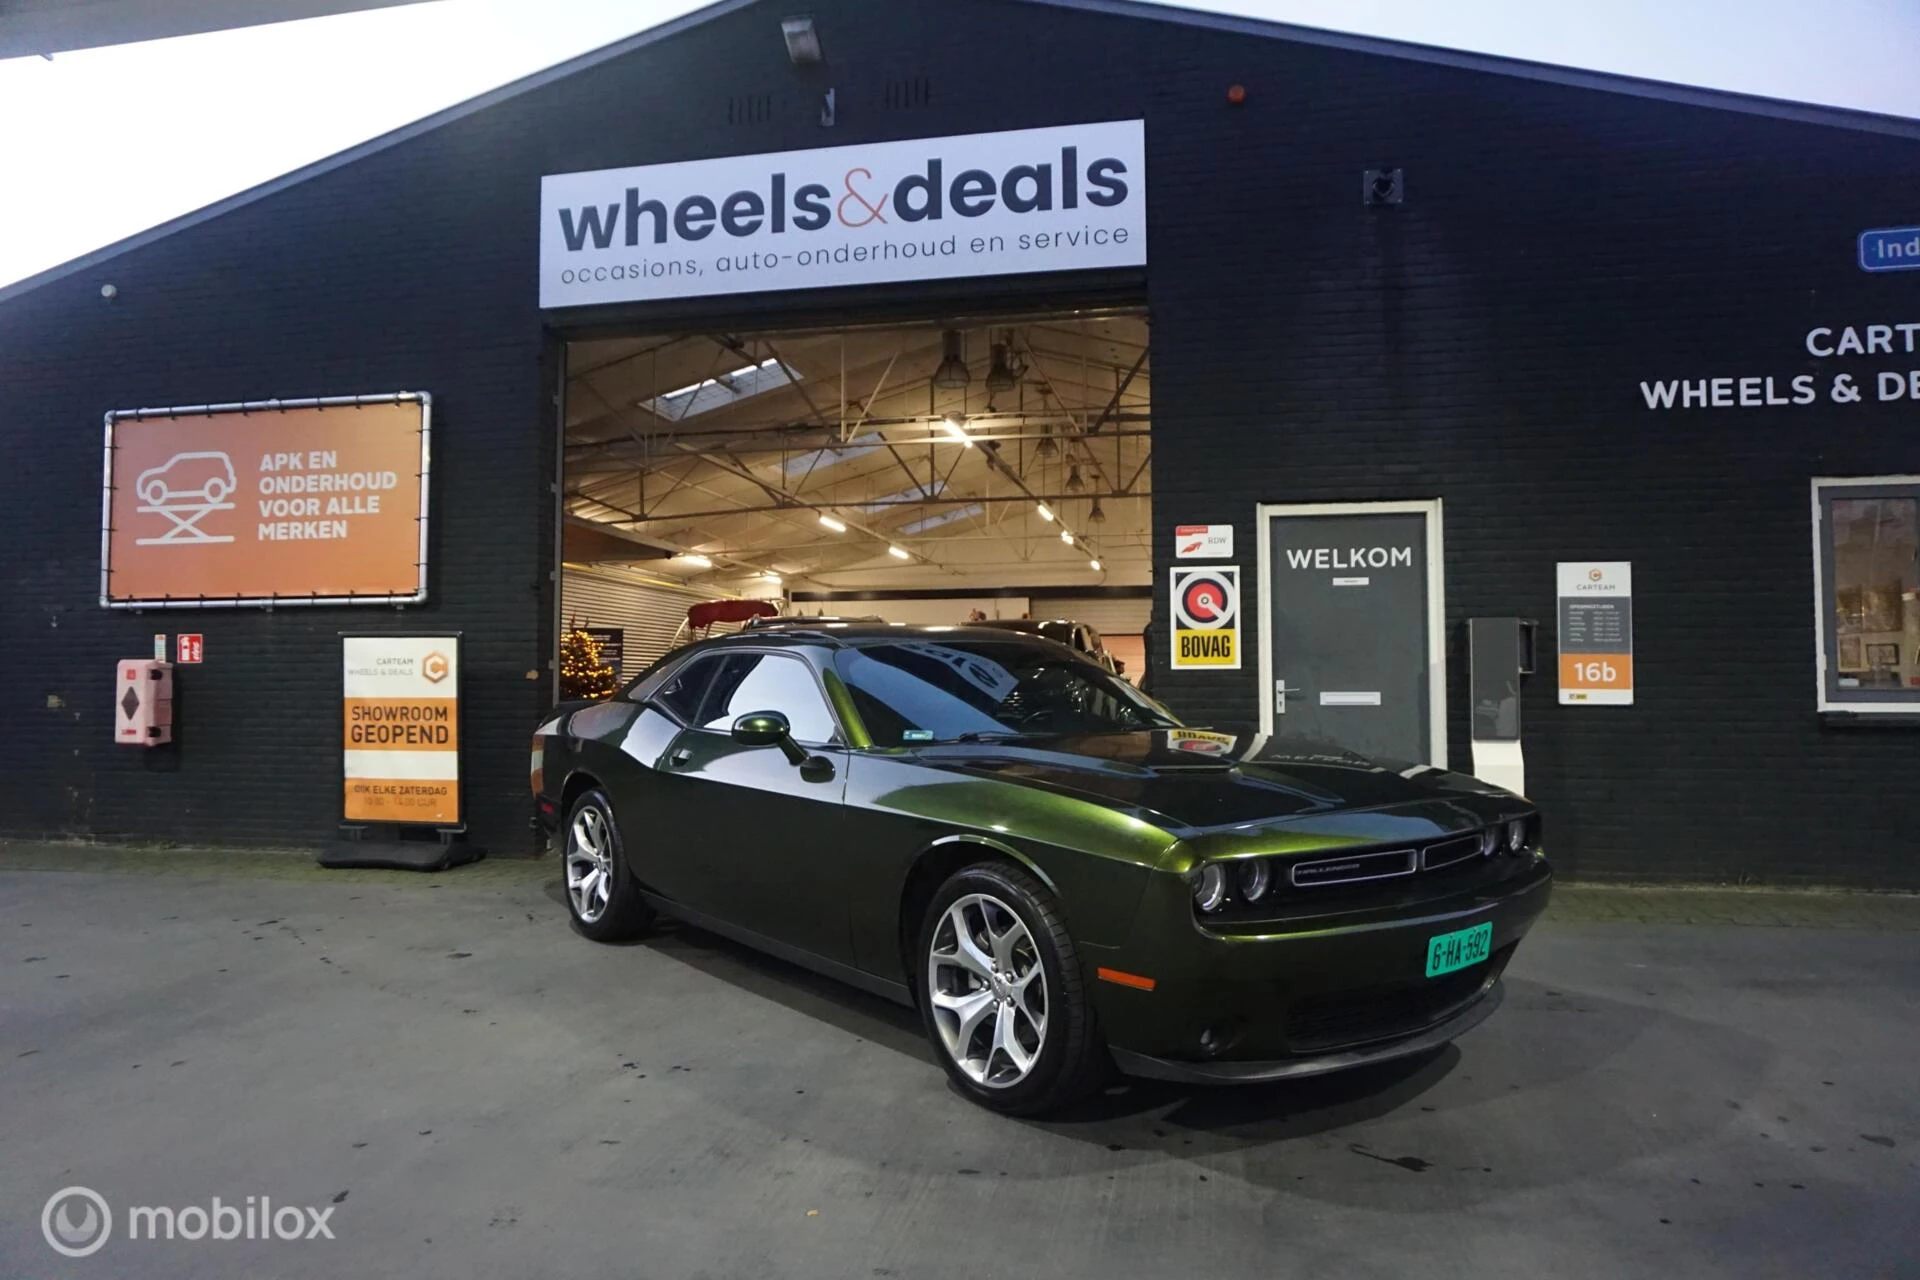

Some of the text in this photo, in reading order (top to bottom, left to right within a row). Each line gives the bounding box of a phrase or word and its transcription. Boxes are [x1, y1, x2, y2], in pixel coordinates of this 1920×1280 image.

[561, 225, 1129, 285] occasions, auto-onderhoud en service
[1878, 236, 1920, 258] Ind
[1806, 323, 1920, 357] CART
[1640, 374, 1816, 409] WHEELS
[1831, 373, 1861, 403] &
[260, 451, 337, 472] APK EN
[259, 471, 397, 495] ONDERHOUD
[259, 495, 380, 518] VOOR ALLE
[258, 520, 347, 541] MERKEN
[1287, 547, 1411, 570] WELKOM
[1181, 635, 1231, 658] BOVAG
[1574, 661, 1617, 683] 16b
[351, 706, 448, 722] SHOWROOM
[351, 725, 449, 745] GEOPEND
[373, 785, 397, 795] ELKE
[399, 785, 448, 796] ZATERDAG
[1432, 929, 1489, 971] 6-HA-592
